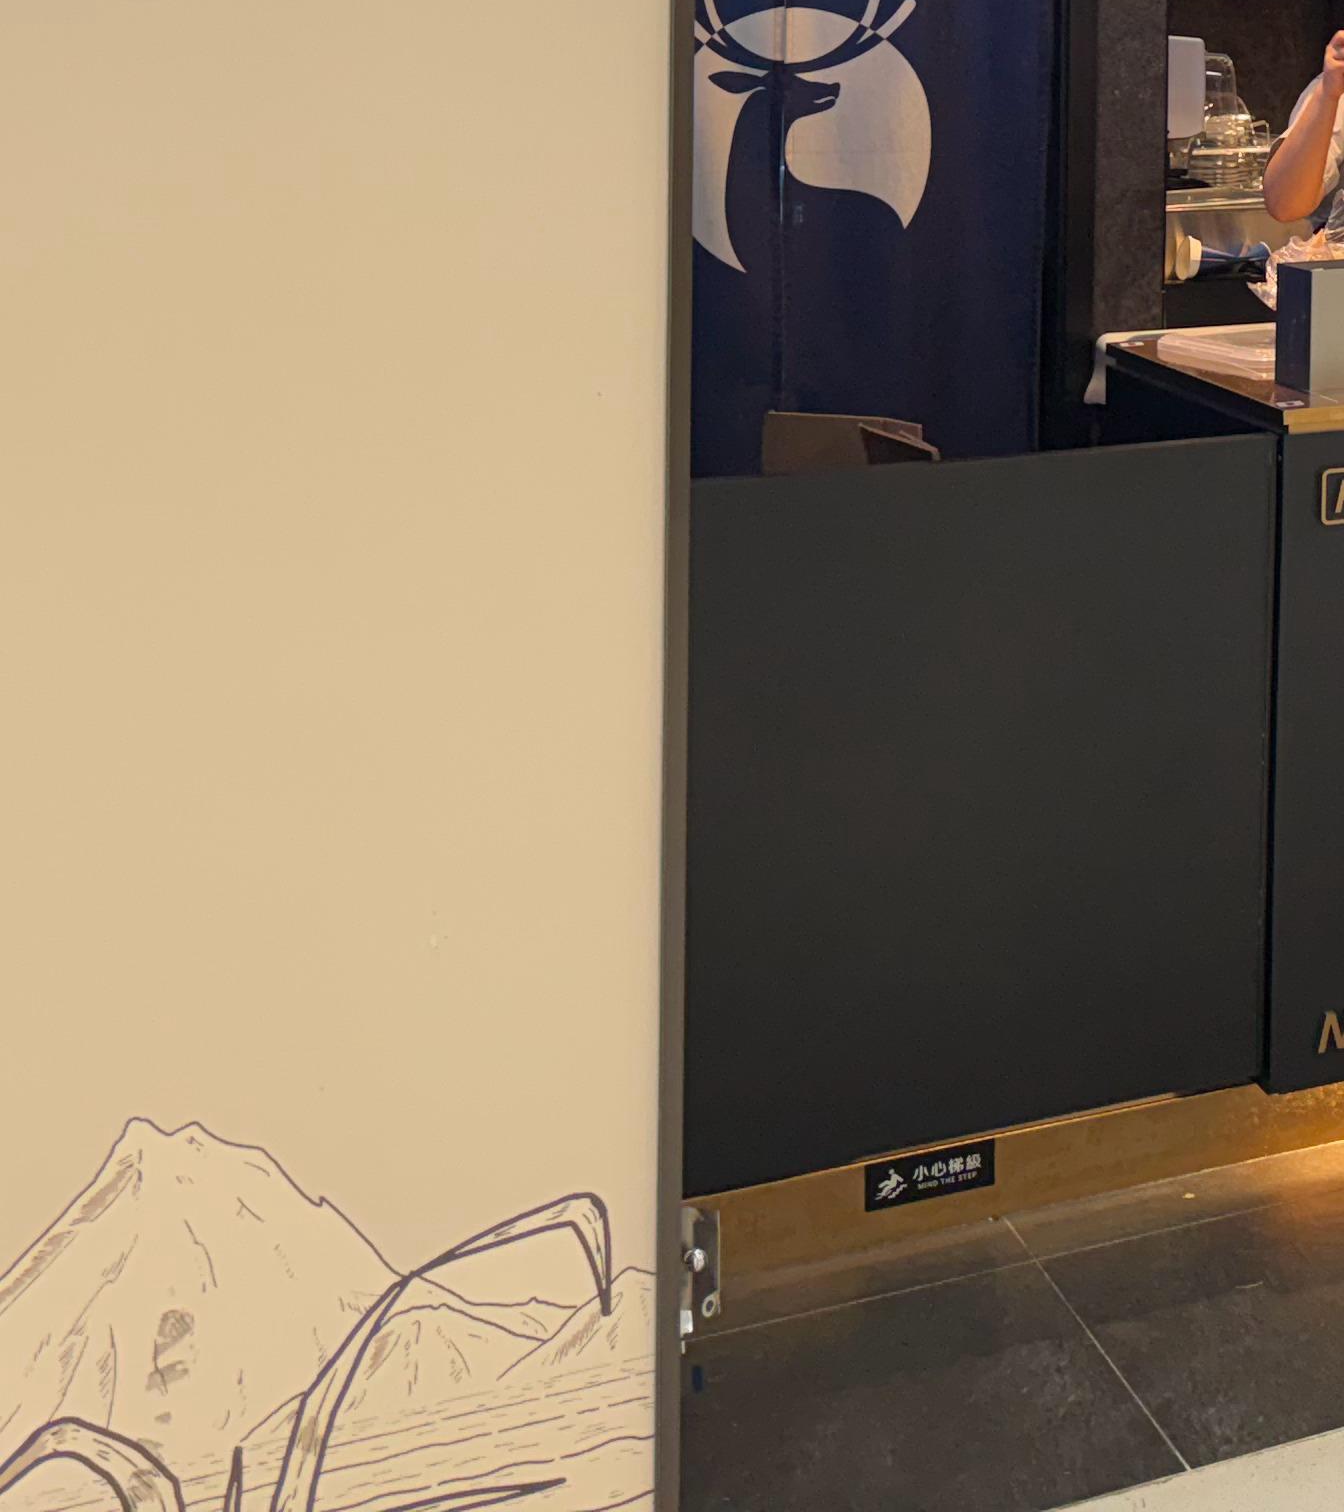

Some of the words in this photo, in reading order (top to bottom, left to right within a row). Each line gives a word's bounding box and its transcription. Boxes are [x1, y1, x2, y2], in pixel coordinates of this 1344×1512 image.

[912, 1153, 982, 1182] 小心梯級
[917, 1179, 939, 1190] MIND
[940, 1176, 956, 1185] THE
[958, 1171, 978, 1182] STEP
